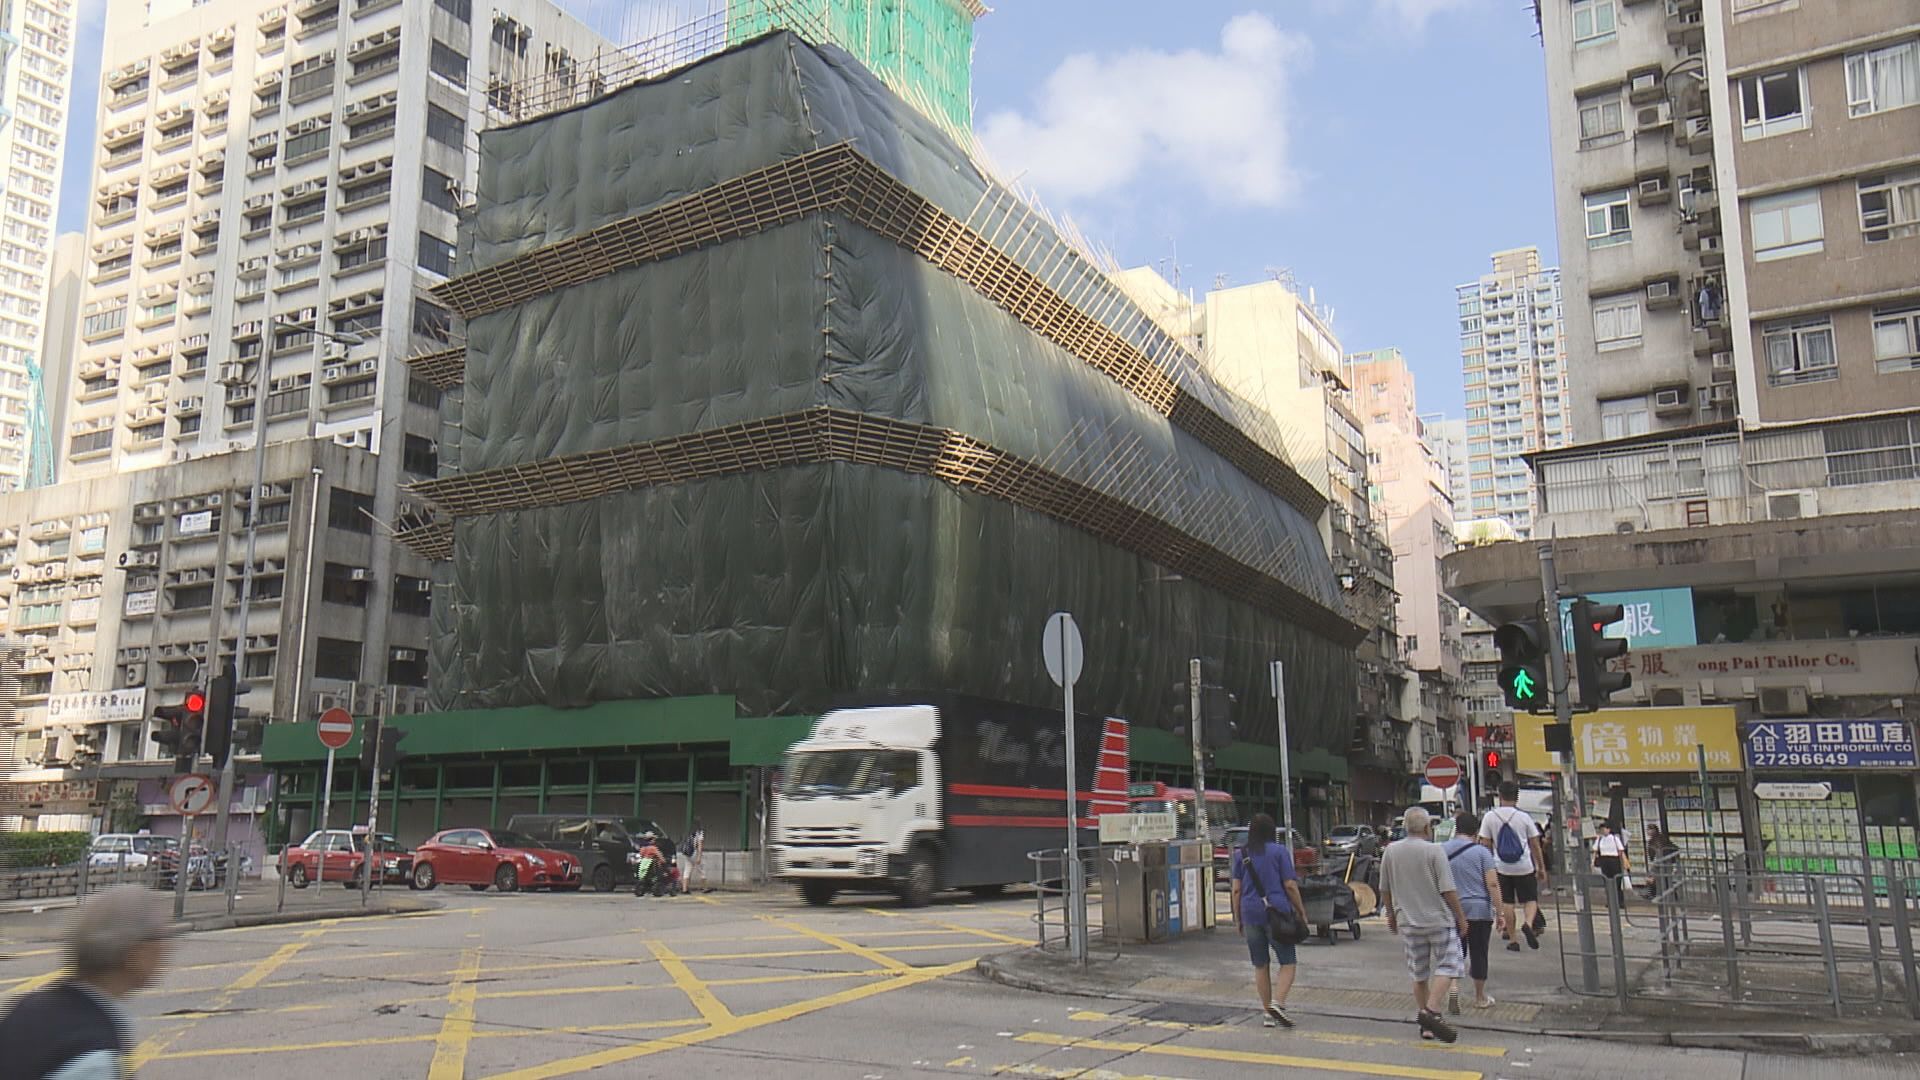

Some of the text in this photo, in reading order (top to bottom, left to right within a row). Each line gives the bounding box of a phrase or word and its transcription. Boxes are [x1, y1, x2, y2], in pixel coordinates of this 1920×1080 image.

[1733, 656, 1760, 670] Pai
[1763, 654, 1820, 669] Tailor
[1824, 653, 1855, 667] Co.
[1786, 744, 1809, 752] YUE
[1812, 744, 1831, 752] TIN
[1641, 751, 1681, 766] 3689
[1755, 753, 1849, 766] 27296649
